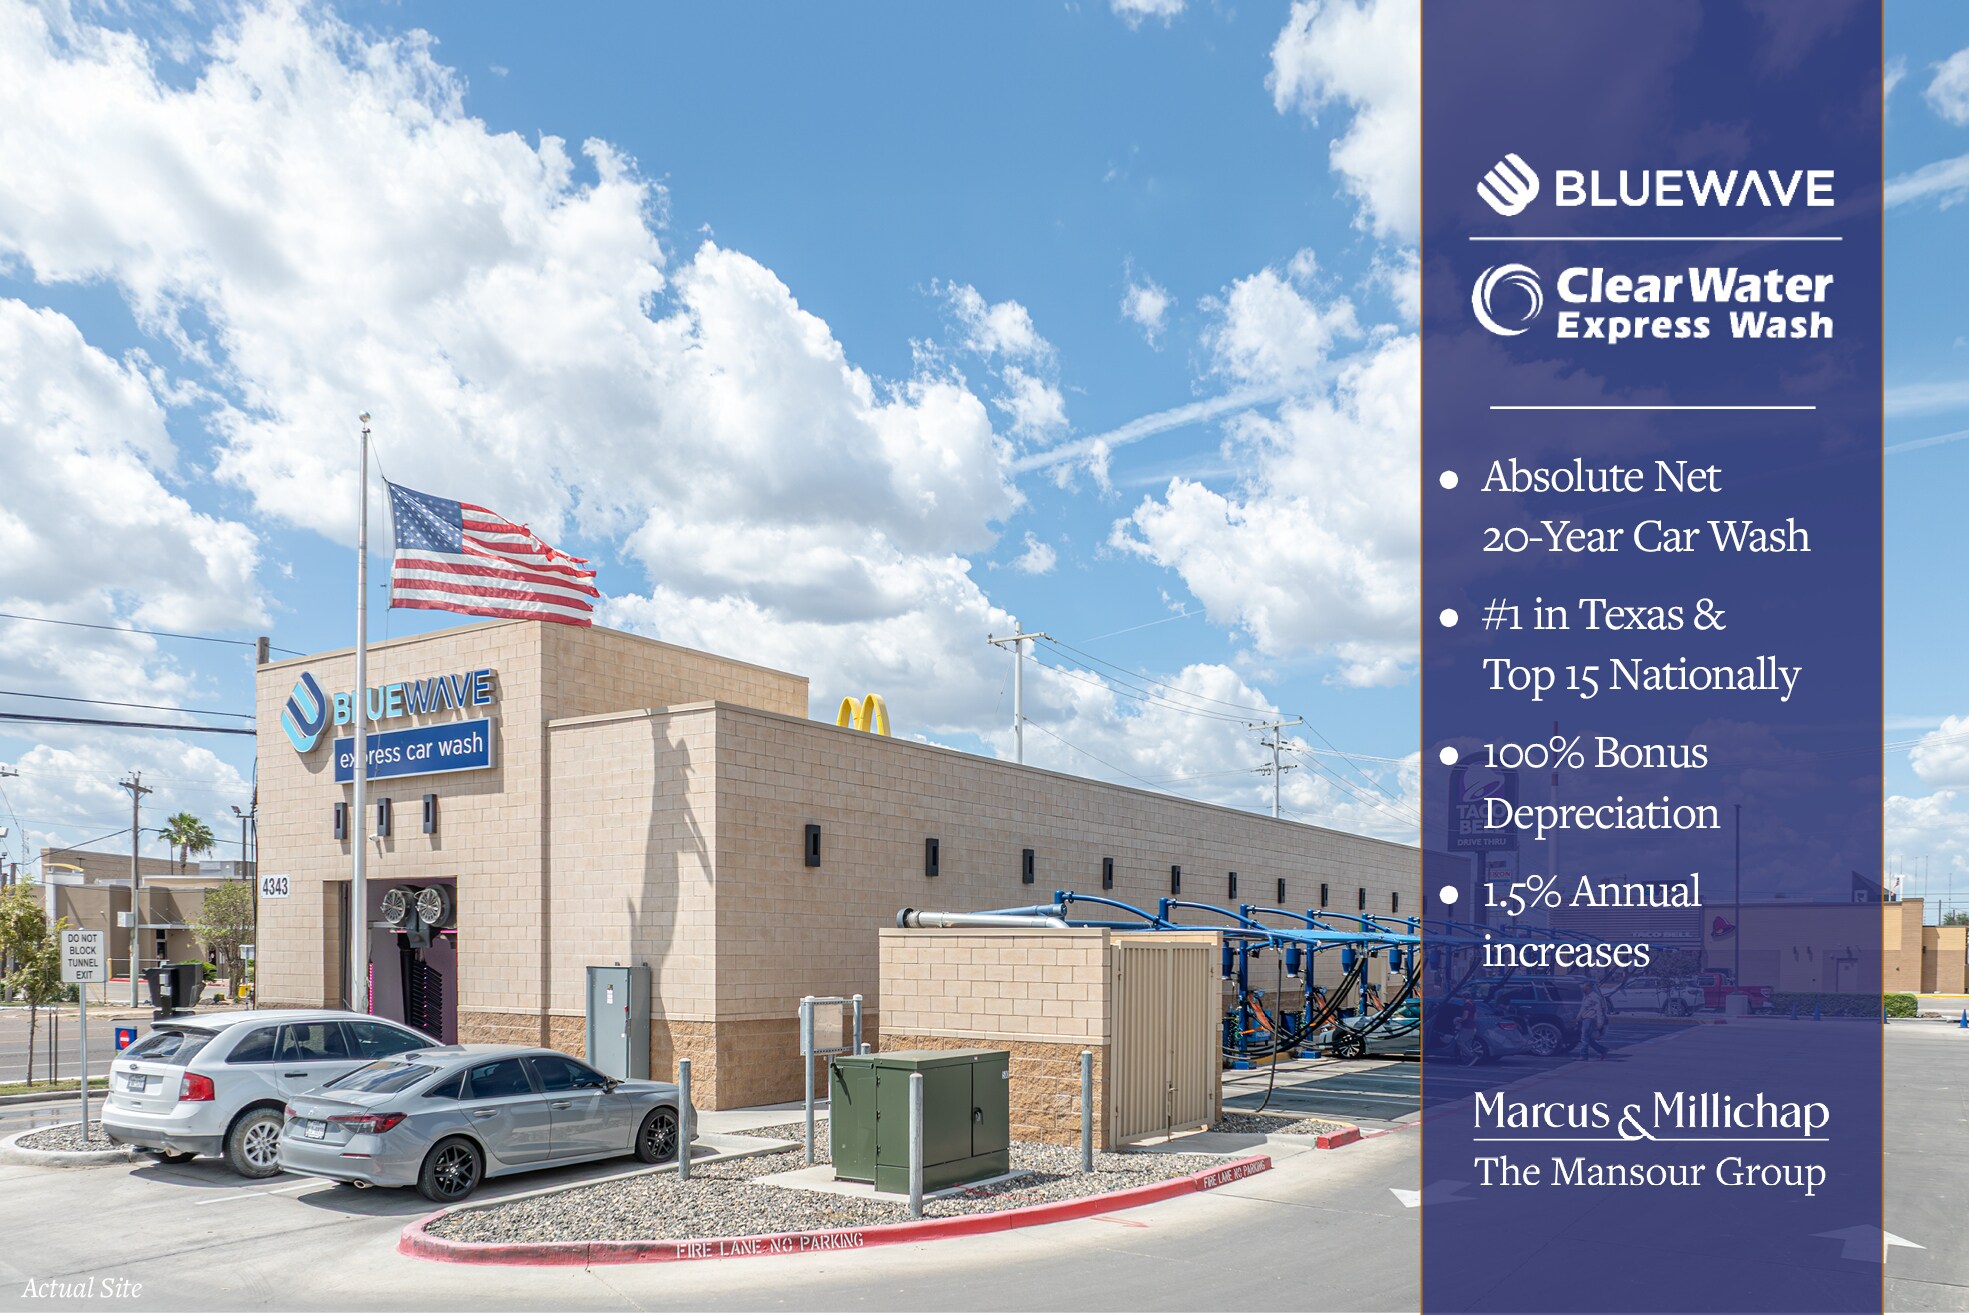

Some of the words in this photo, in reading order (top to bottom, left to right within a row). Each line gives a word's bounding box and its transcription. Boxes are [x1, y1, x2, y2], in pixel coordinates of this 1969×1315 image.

[340, 746, 401, 769] exress
[406, 742, 433, 761] car
[438, 731, 483, 757] wash
[1456, 804, 1506, 819] TACO
[1457, 838, 1482, 846] DRIVE
[1483, 838, 1506, 846] THRU
[262, 877, 288, 896] 4343
[68, 934, 80, 943] DO
[81, 934, 97, 943] NOT
[69, 946, 97, 955] BLOCK
[68, 958, 99, 967] TUNNEL
[76, 970, 93, 980] EXIT
[1203, 1174, 1217, 1188] FIRE
[1218, 1168, 1233, 1184] LANE
[1233, 1167, 1242, 1180] NO
[1243, 1160, 1266, 1176] PARKING
[676, 1242, 712, 1259] FIRE
[719, 1239, 762, 1256] LANE
[770, 1237, 793, 1253] NO
[800, 1232, 864, 1251] PARKING
